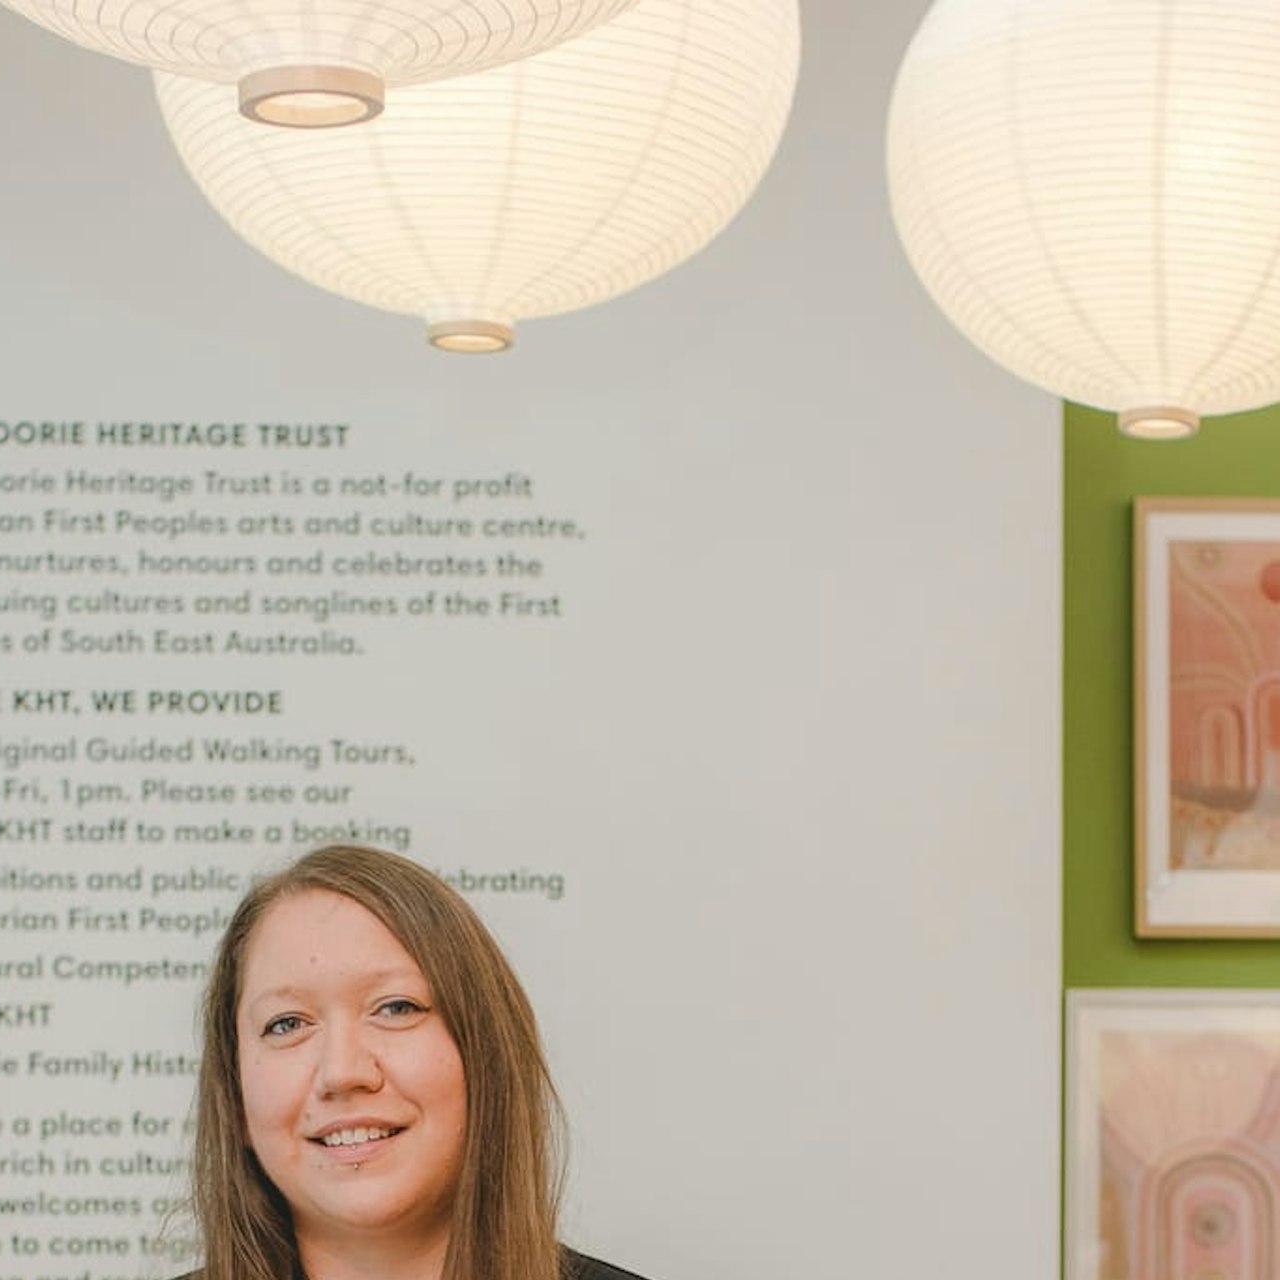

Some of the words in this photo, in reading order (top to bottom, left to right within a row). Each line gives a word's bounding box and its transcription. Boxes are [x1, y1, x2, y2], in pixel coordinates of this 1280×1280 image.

[97, 423, 245, 447] HERITAGE
[257, 425, 349, 448] TRUST
[67, 471, 192, 501] Heritage
[206, 472, 270, 494] Trust
[282, 473, 302, 494] is
[313, 479, 330, 495] a
[341, 472, 443, 496] not-for
[454, 473, 531, 501] profit
[45, 510, 104, 532] First
[116, 511, 227, 538] Peoples
[238, 515, 294, 534] arts
[305, 513, 360, 535] and
[371, 514, 471, 535] culture
[483, 517, 585, 539] centre,
[139, 551, 256, 573] honours
[267, 552, 322, 574] and
[333, 553, 486, 575] celebrates
[497, 553, 542, 576] the
[68, 591, 184, 612] cultures
[195, 591, 250, 614] and
[262, 592, 397, 622] songlines
[407, 591, 435, 614] of
[444, 592, 490, 615] the
[500, 593, 560, 616] First
[23, 629, 51, 652] of
[62, 630, 143, 652] South
[155, 630, 213, 653] East
[225, 631, 363, 654] Australia.
[13, 690, 80, 715] KHT,
[92, 691, 135, 713] WE
[148, 691, 281, 714] PROVIDE
[86, 739, 193, 762] Guided
[205, 740, 321, 770] Walking
[331, 740, 414, 764] Tours,
[63, 780, 129, 807] 1pm.
[142, 780, 235, 802] Please
[247, 787, 294, 801] see
[305, 787, 351, 802] our
[64, 818, 127, 842] staff
[137, 823, 164, 842] to
[175, 820, 253, 842] make
[266, 827, 280, 841] a
[293, 821, 410, 849] booking
[87, 868, 141, 890] and
[153, 868, 237, 899] public
[451, 867, 565, 899] ebrating
[69, 908, 128, 930] First
[139, 906, 231, 937] Peopl
[54, 954, 206, 982] Competen
[29, 1052, 123, 1081] Family
[13, 1119, 30, 1135] a
[41, 1112, 121, 1140] place
[133, 1112, 168, 1135] for
[0, 1152, 54, 1175] rich
[65, 1153, 89, 1173] in
[100, 1153, 194, 1181] cultur
[12, 1235, 39, 1254] to
[49, 1238, 128, 1254] come
